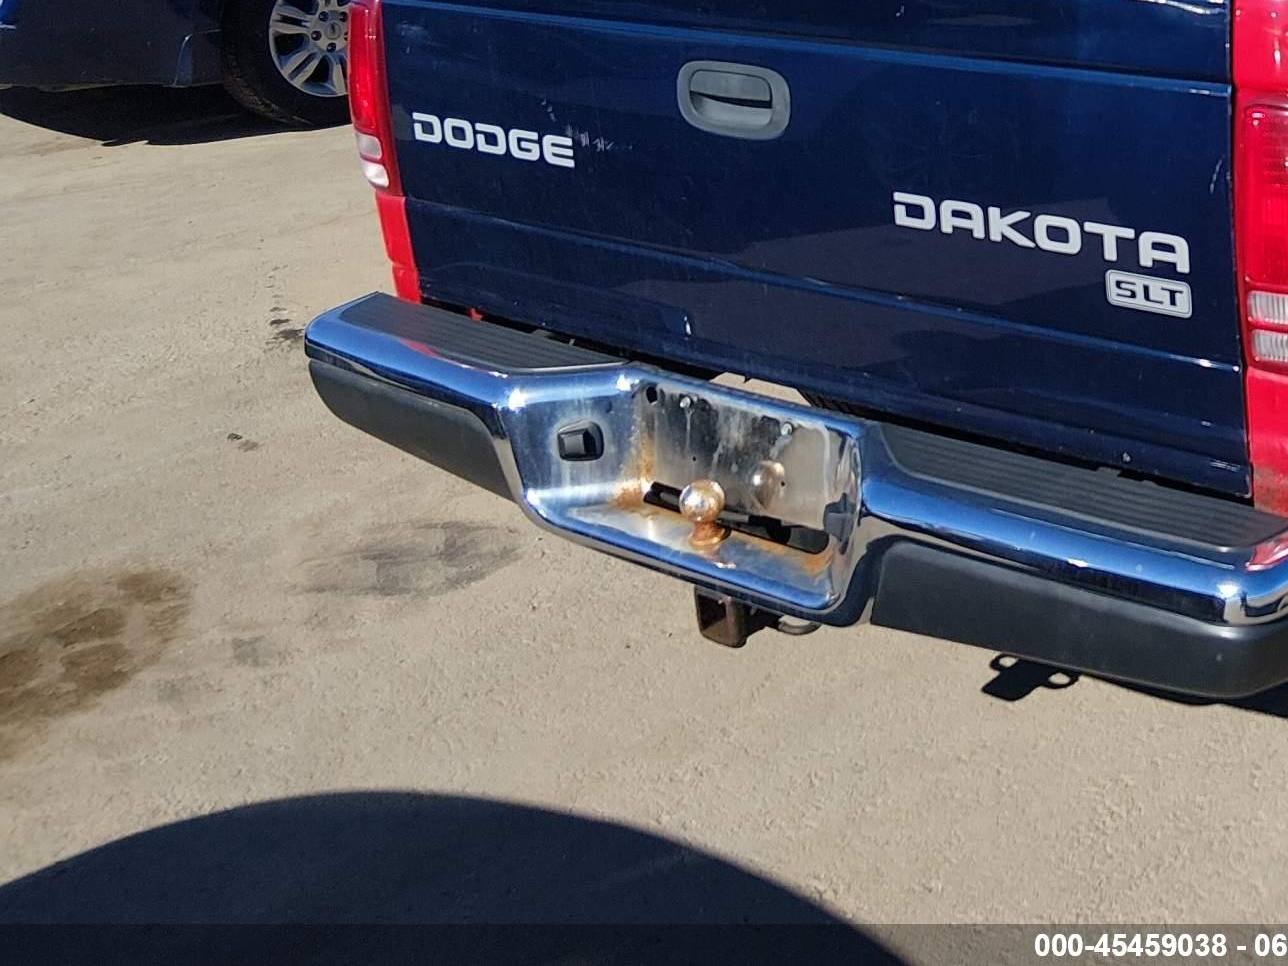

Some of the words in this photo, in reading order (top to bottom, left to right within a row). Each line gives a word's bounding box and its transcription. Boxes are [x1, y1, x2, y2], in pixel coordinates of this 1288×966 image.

[412, 112, 575, 168] DODGE
[893, 191, 1190, 274] DAKOTA
[1115, 280, 1183, 307] SLT
